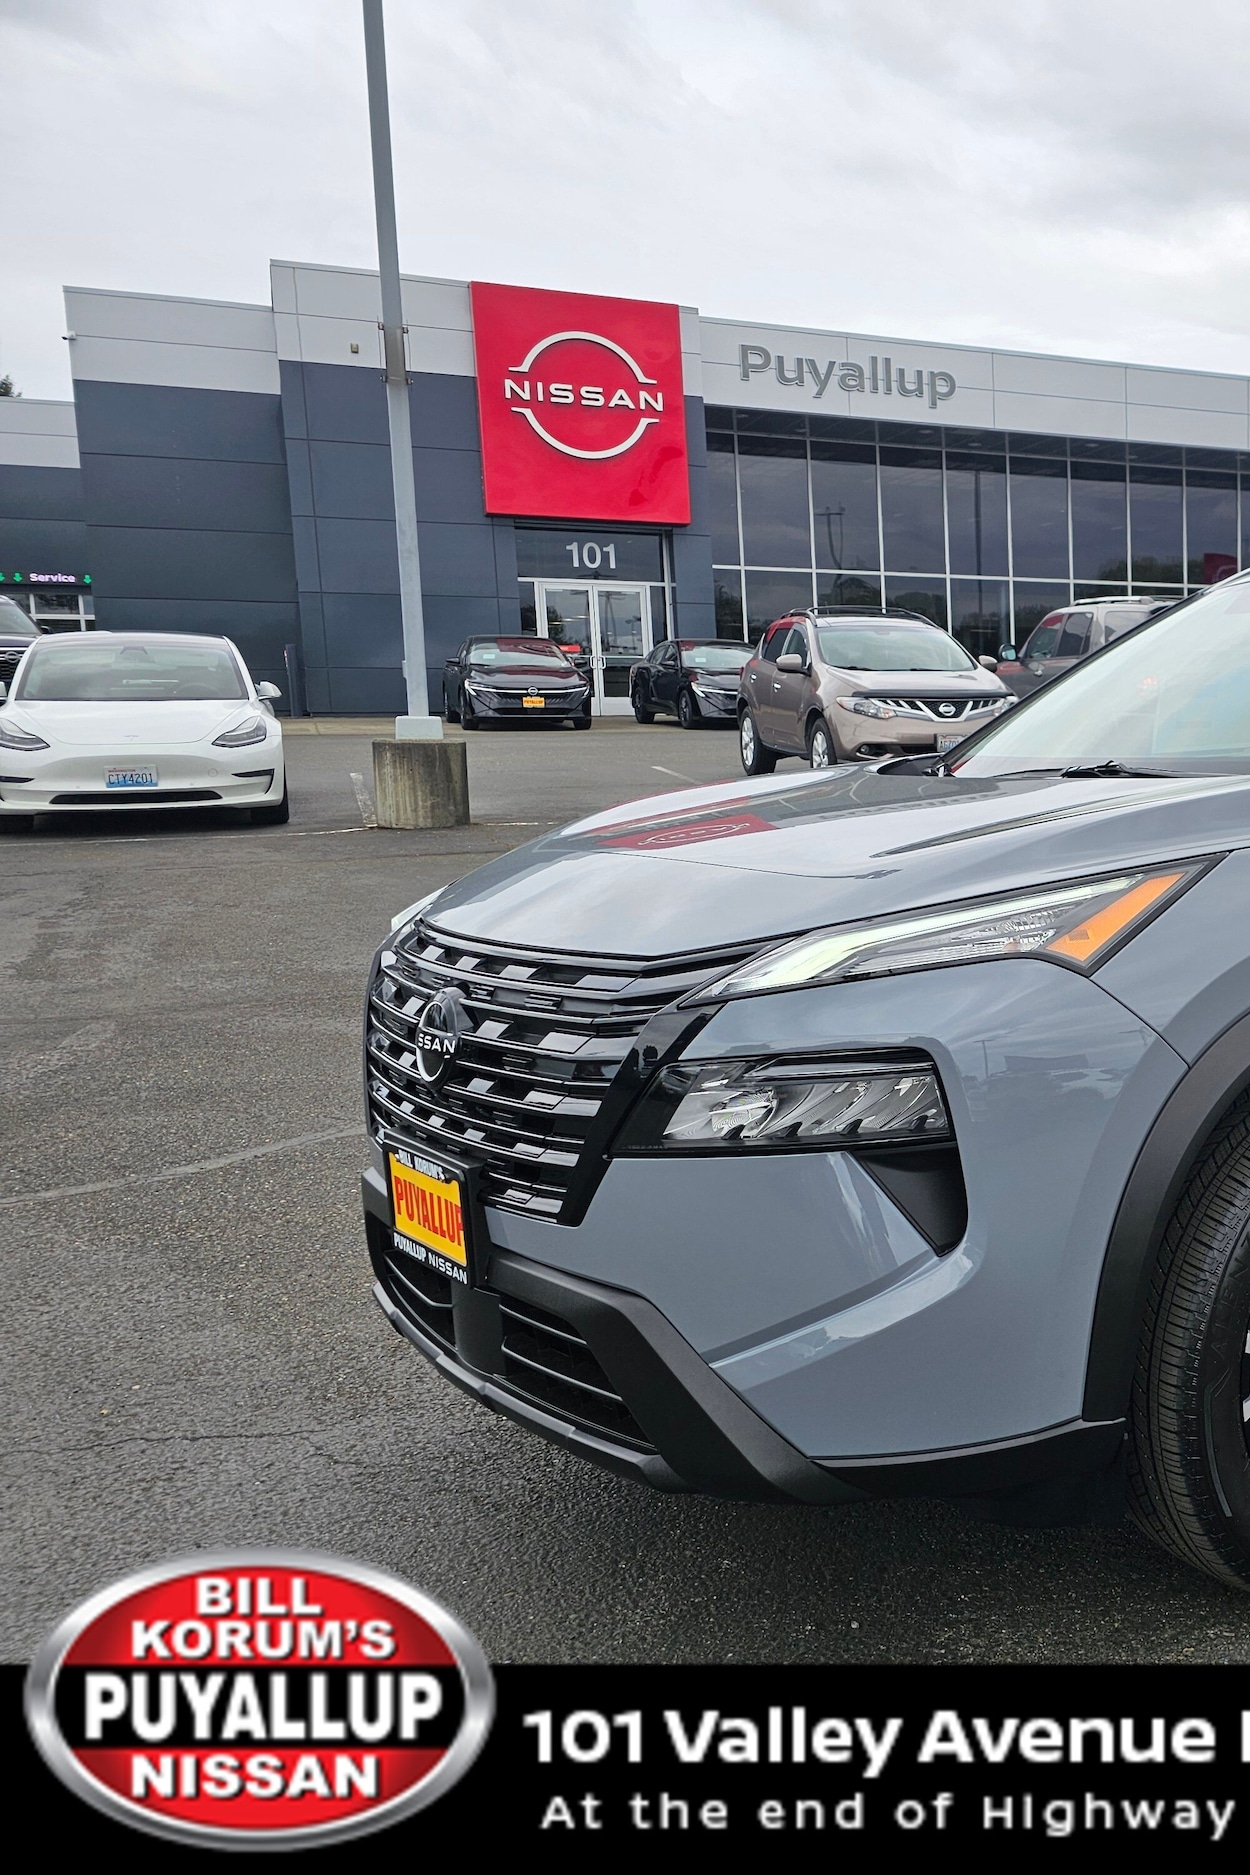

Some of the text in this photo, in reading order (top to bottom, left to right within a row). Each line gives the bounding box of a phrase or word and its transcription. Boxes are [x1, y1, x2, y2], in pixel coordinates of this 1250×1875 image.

[739, 343, 957, 409] Puyallup
[504, 377, 664, 412] NISSAN
[565, 541, 617, 570] 101
[29, 573, 76, 583] Service
[108, 772, 153, 785] CTY4201
[393, 1175, 464, 1247] PUYALLUP
[393, 1232, 468, 1285] PUYALLUP NISSAN
